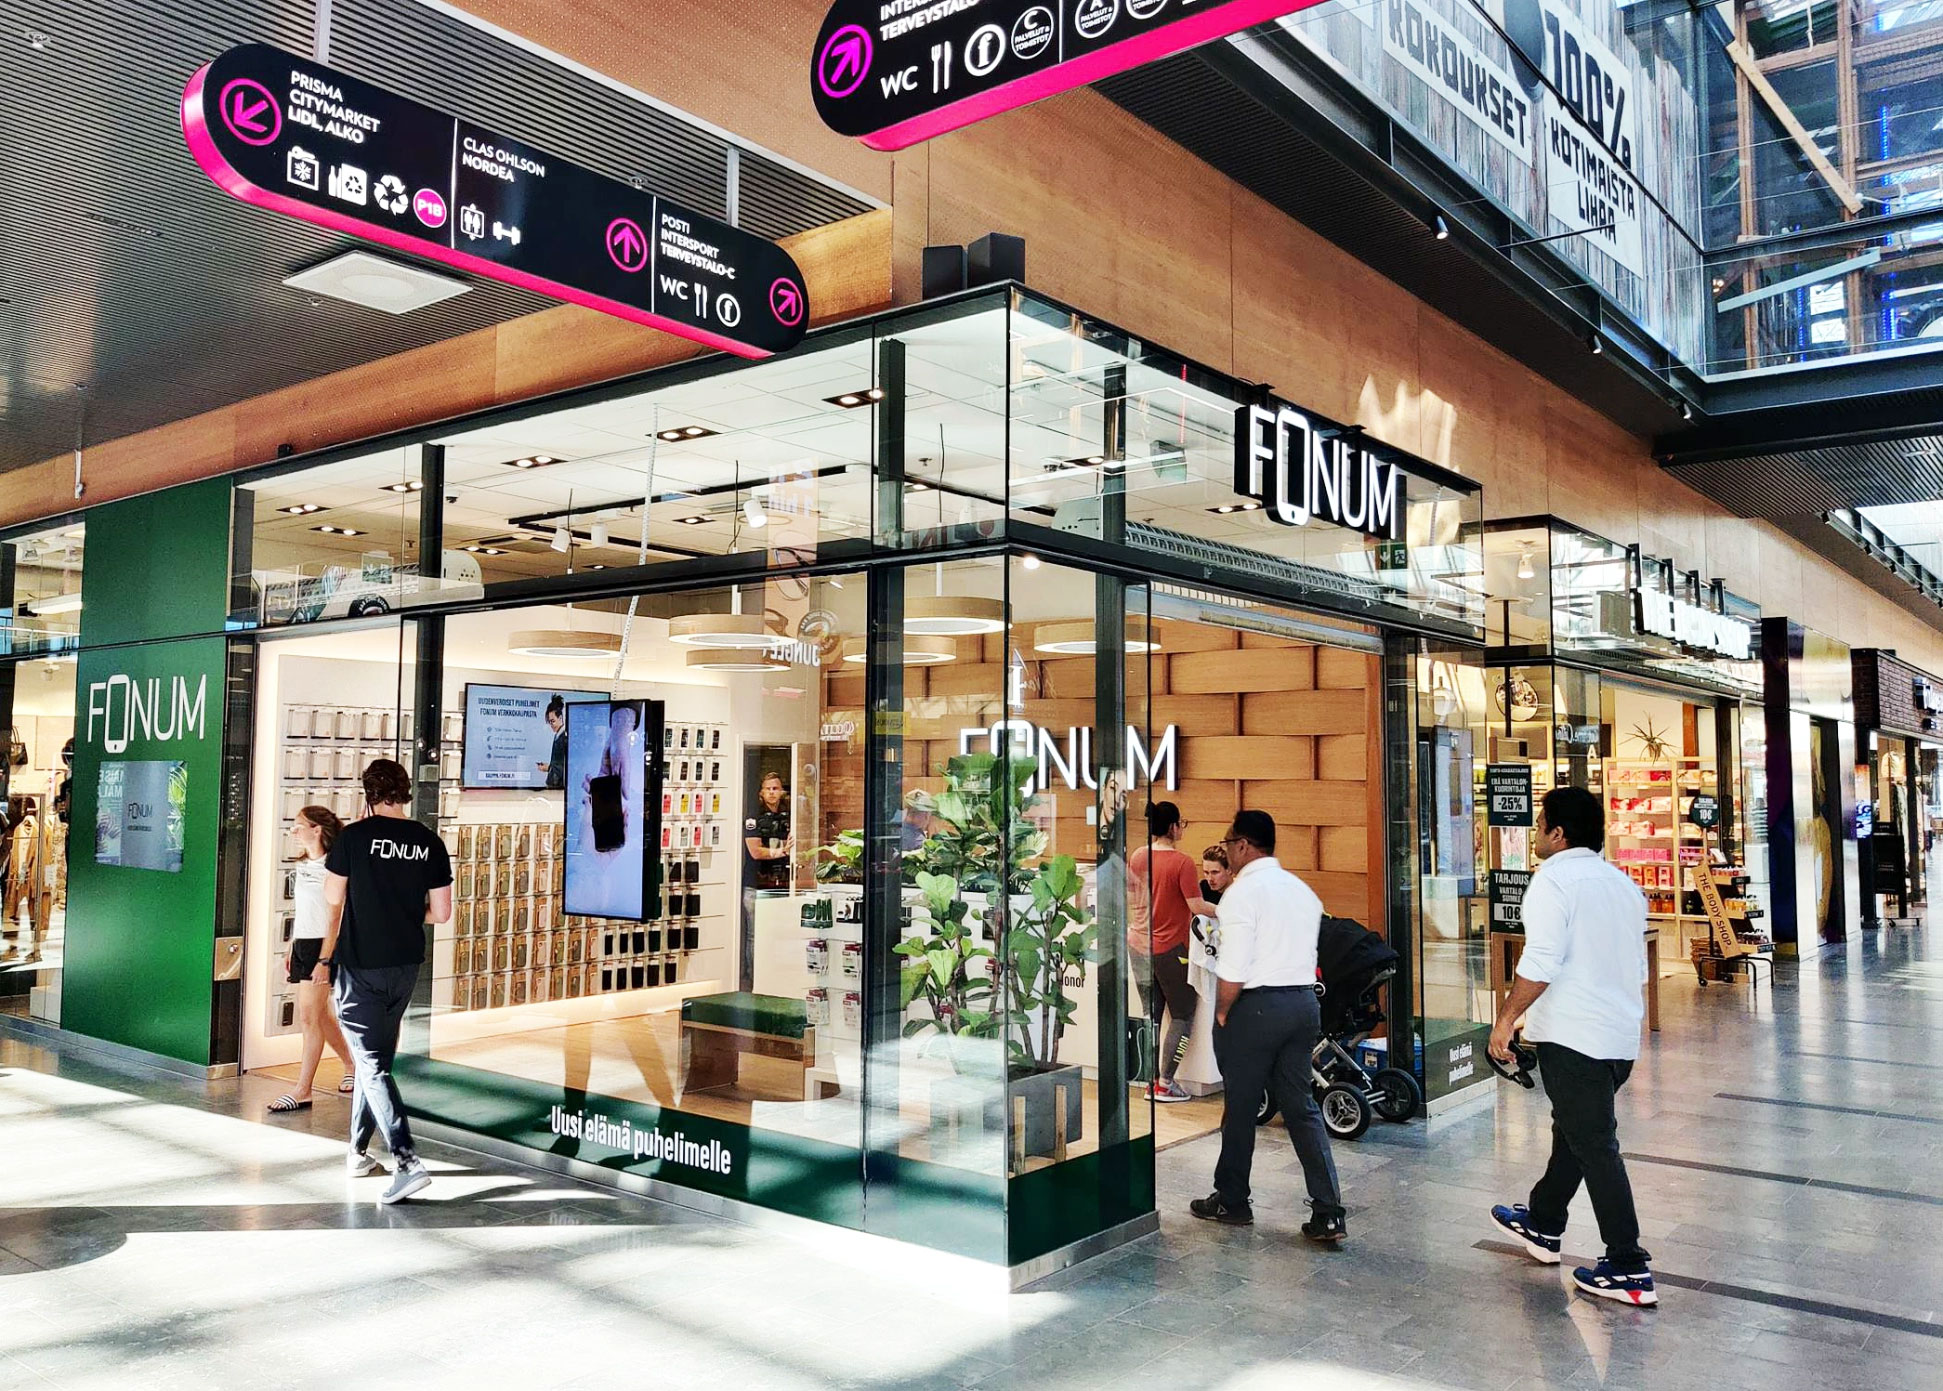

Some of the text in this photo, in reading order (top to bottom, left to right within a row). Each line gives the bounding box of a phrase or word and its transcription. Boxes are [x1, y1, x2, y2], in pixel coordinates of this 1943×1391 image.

[1024, 10, 1039, 30] C
[1015, 33, 1049, 51] TOIMISTOT
[291, 70, 343, 102] PRISMA
[880, 65, 919, 100] WC
[1388, 0, 1527, 148] KOKOUKSET
[1545, 10, 1632, 170] 100%
[288, 105, 364, 144] LIDL, ALKO
[289, 89, 381, 132] CITYMARKET
[462, 152, 515, 182] NORDEA
[463, 137, 545, 178] CLAS OHLSON
[1551, 117, 1635, 221] KOTIMAISTA
[661, 213, 690, 235] POSTI
[1577, 180, 1616, 245] LIHAA
[660, 242, 736, 280] TERVEYSTALO-C
[661, 228, 719, 259] INTERSPORT
[660, 274, 689, 300] WC
[1249, 404, 1397, 539] FONUM
[88, 674, 207, 754] FONUM
[128, 803, 153, 819] FONUM
[1498, 797, 1522, 810] -25%
[370, 839, 429, 861] FONUM
[1494, 873, 1529, 886] TARJOUS
[1698, 872, 1732, 947] THE BODY SHOP
[1061, 974, 1085, 988] onor
[551, 1105, 732, 1175] Uusi elämä puhelimelle
